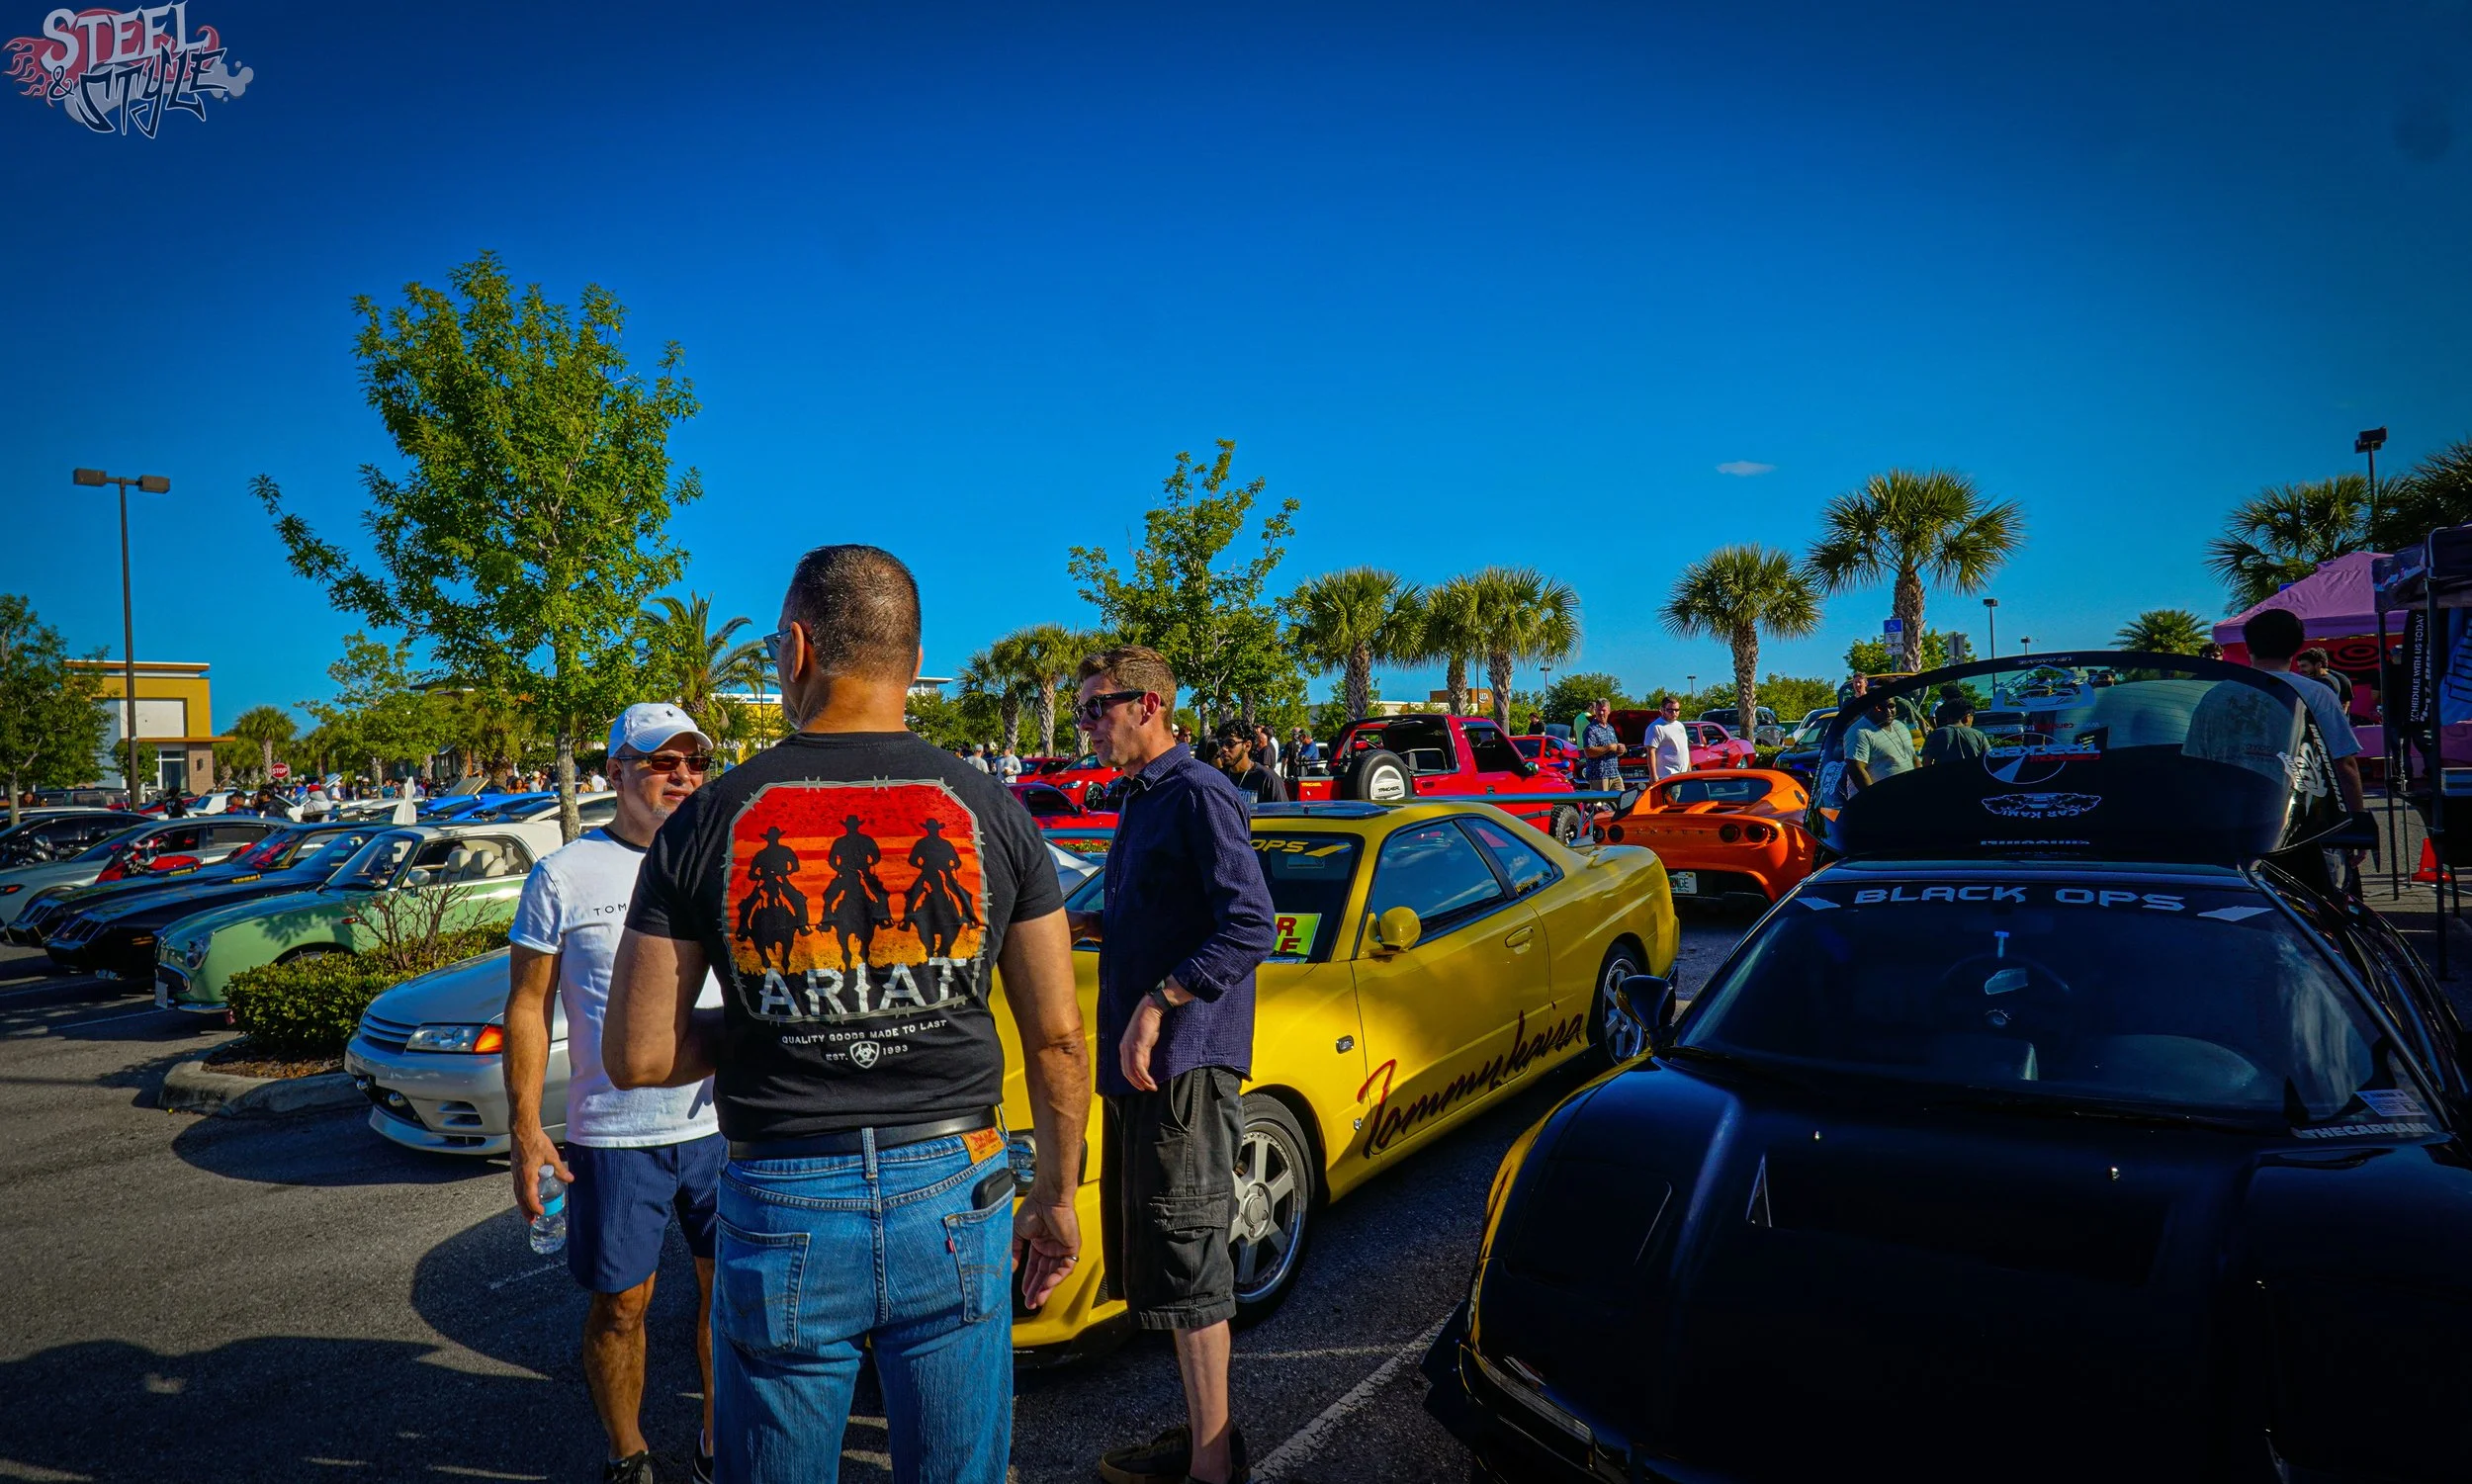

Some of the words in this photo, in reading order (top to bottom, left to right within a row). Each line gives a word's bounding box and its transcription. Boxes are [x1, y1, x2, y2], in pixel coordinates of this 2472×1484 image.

[2415, 613, 2426, 643] TODAY
[2414, 643, 2423, 655] US
[2413, 655, 2422, 677] WITH
[2410, 677, 2421, 723] SCHEDULE
[2001, 808, 2043, 820] KAMI
[2047, 808, 2080, 818] CAR
[1251, 839, 1309, 852] OPS
[1854, 886, 2028, 905] BLACK
[2055, 887, 2186, 912] OPS
[759, 956, 967, 1017] ARIAT
[781, 1034, 825, 1045] QUALITY
[829, 1030, 865, 1041] GOODS
[869, 1027, 899, 1039] MADE
[902, 1025, 916, 1034] TO
[920, 1019, 947, 1031] LAST
[826, 1052, 848, 1061] EST.
[882, 1044, 909, 1056] 1993
